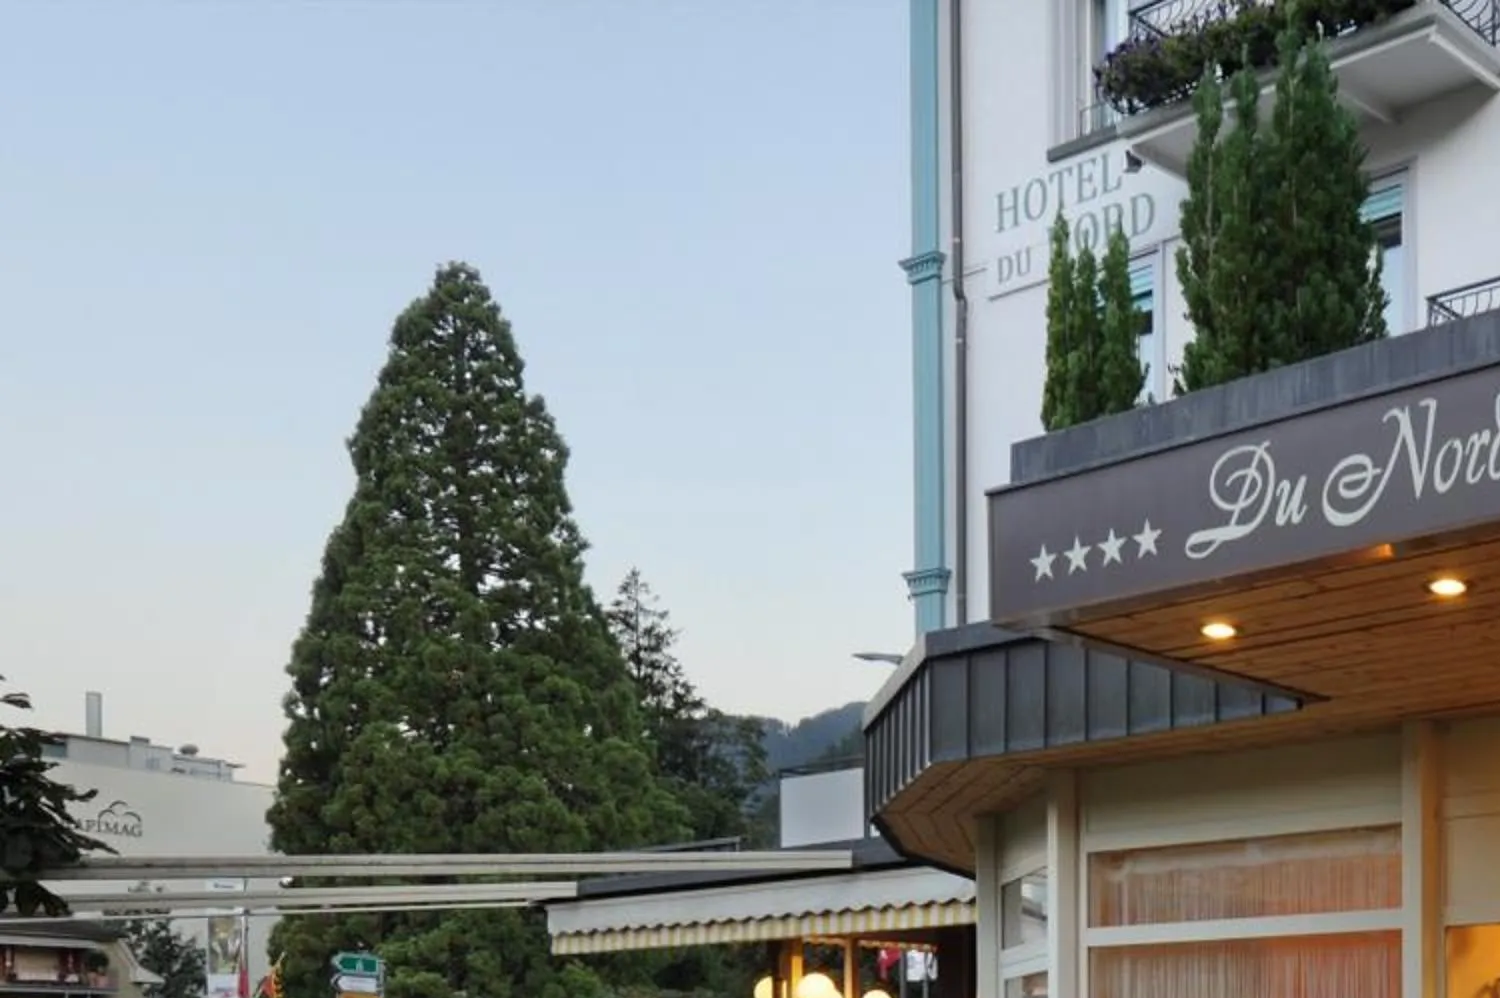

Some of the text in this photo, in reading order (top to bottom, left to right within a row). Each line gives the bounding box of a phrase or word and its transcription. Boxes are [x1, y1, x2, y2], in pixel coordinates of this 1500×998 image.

[995, 152, 1123, 235] HOTEL
[997, 192, 1156, 286] DU ORD
[1184, 441, 1309, 560] Du
